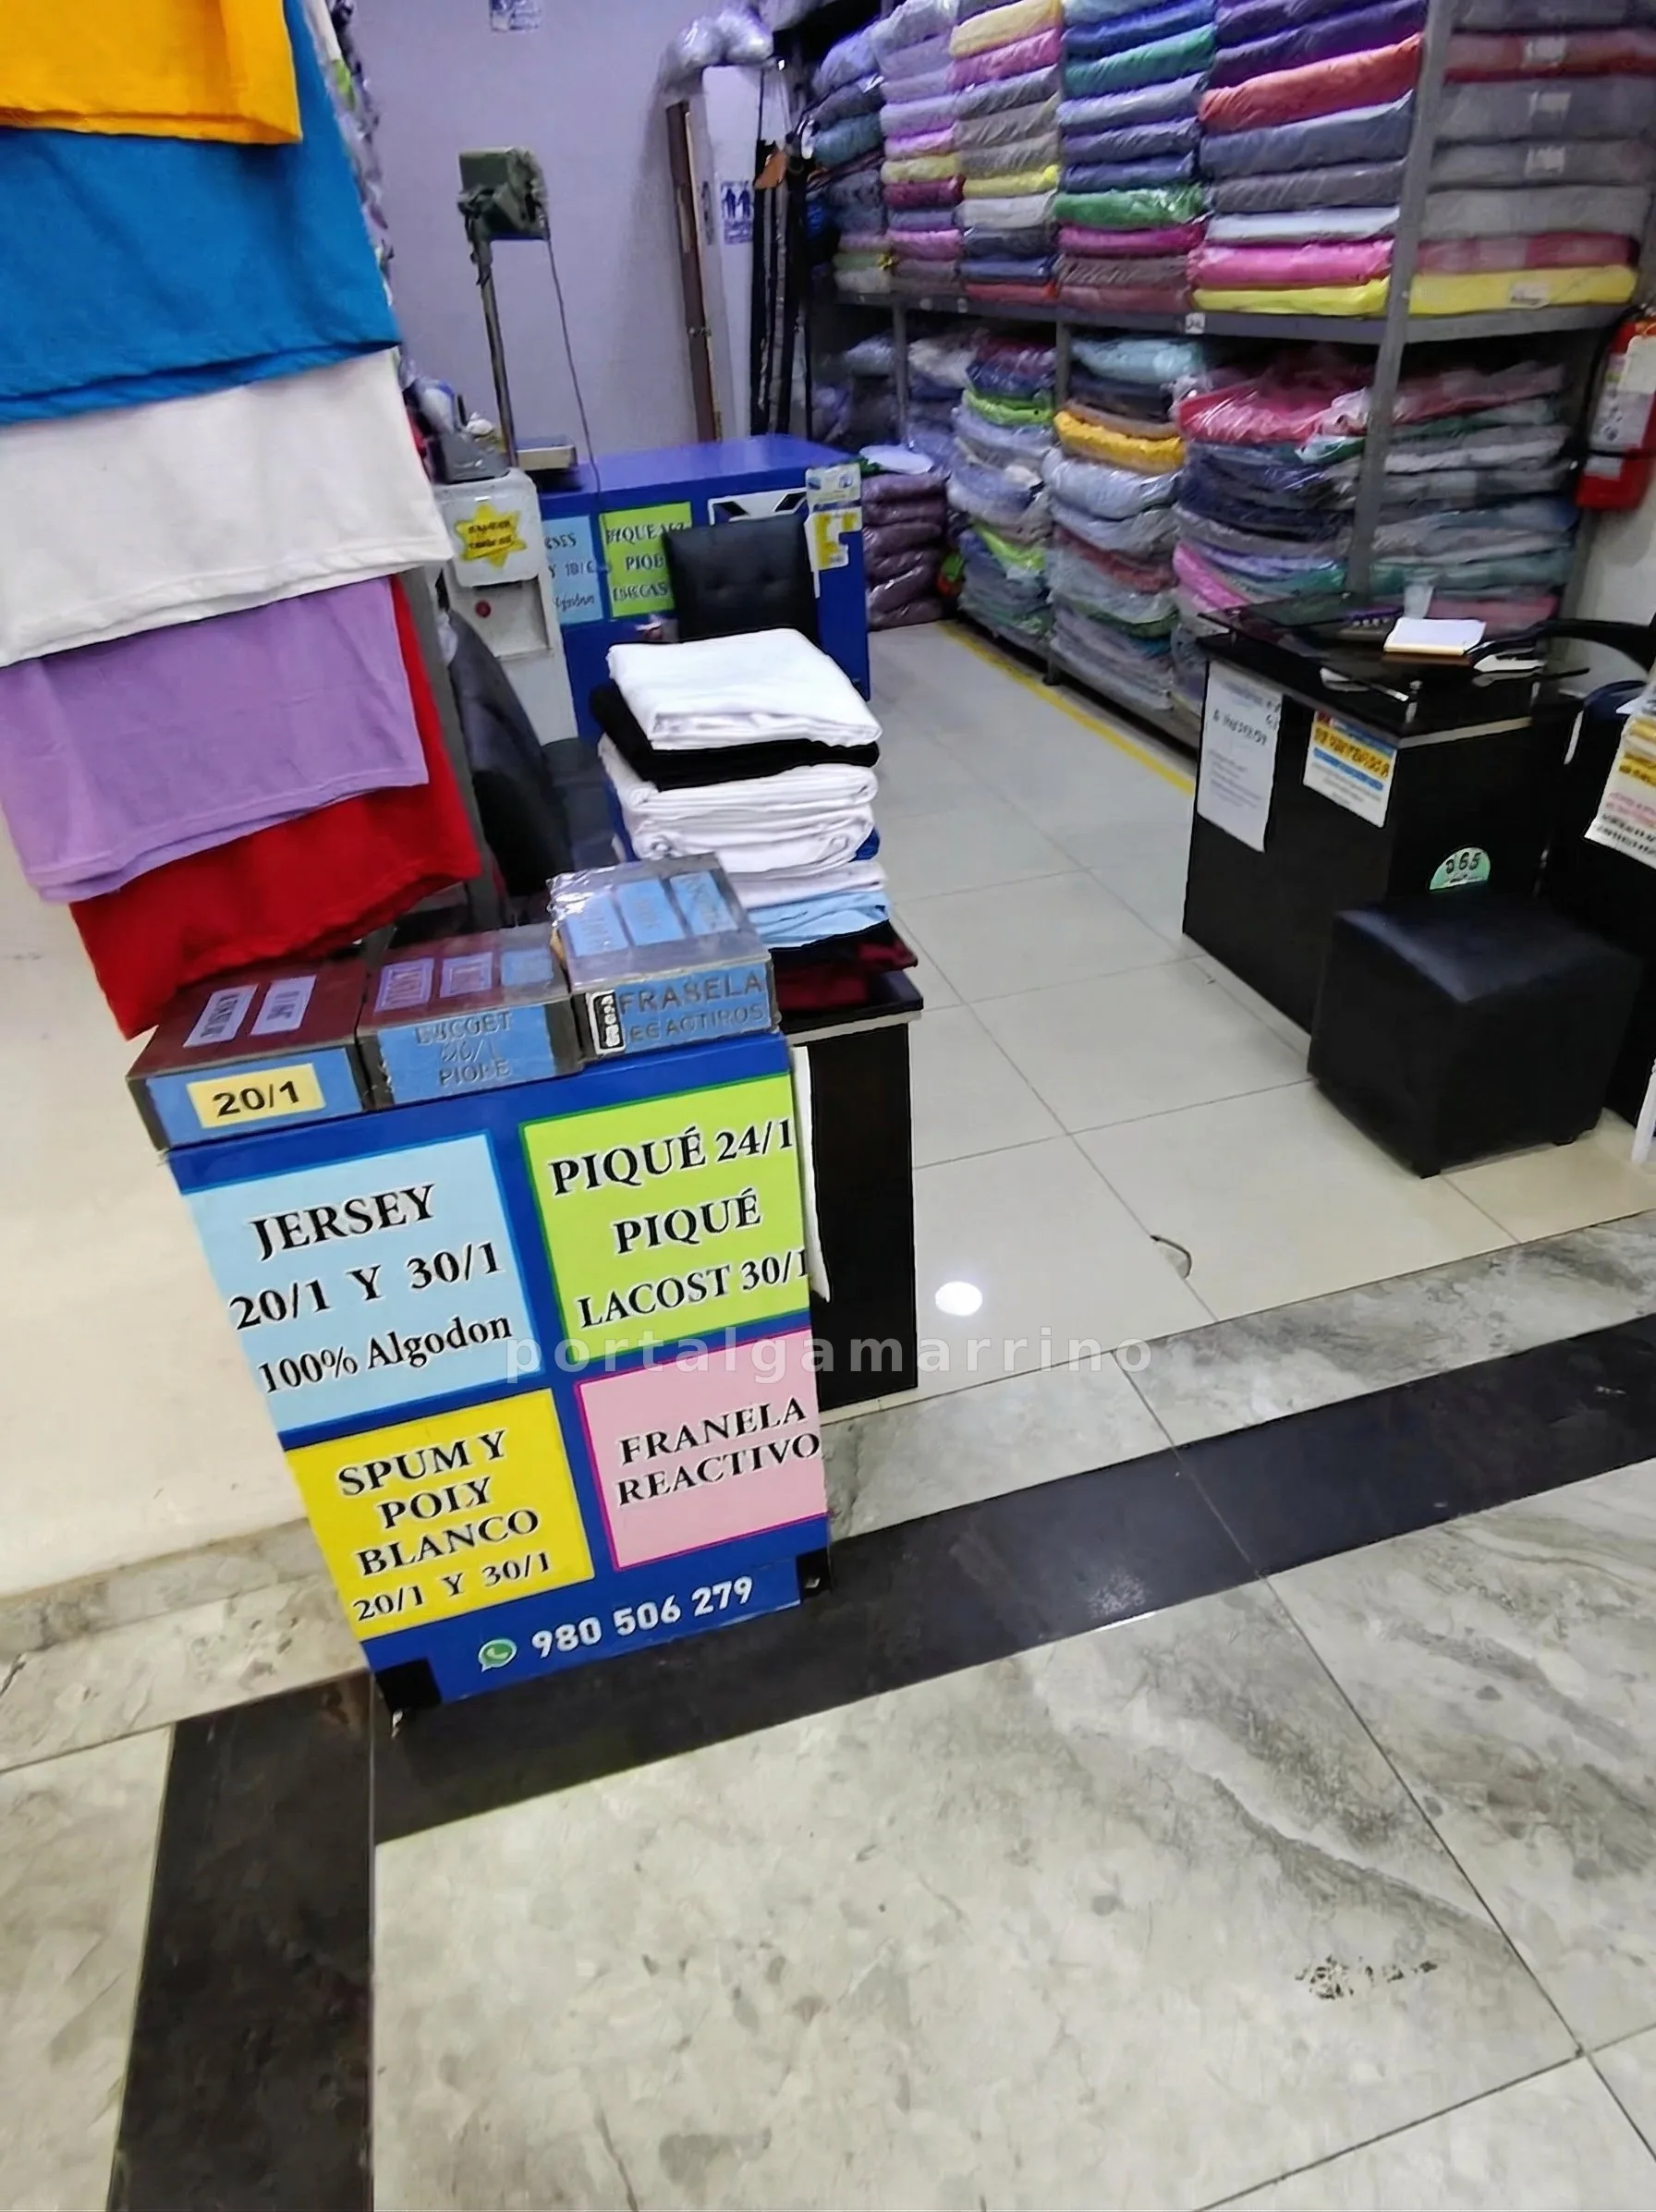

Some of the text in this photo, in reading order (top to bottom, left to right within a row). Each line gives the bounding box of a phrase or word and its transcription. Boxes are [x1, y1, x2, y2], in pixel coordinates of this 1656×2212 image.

[213, 1080, 300, 1118] 20/1
[548, 1118, 794, 1197] PIQUÉ 24/1
[250, 1184, 436, 1261] JERSEY
[614, 1187, 762, 1255] PIQUÉ
[229, 1242, 502, 1331] 20/1 Y 30/1
[578, 1247, 809, 1329] LACOST 30/1
[259, 1316, 513, 1393] 100% Algodon
[338, 1430, 506, 1497] SPUM Y
[619, 1397, 807, 1466] FRANELA
[378, 1477, 492, 1529] POLY
[616, 1432, 821, 1506] REACTIVO
[356, 1509, 539, 1576] BLANCO
[353, 1551, 551, 1623] 20/1 Y 30/1
[530, 1575, 754, 1659] 980 506 279
